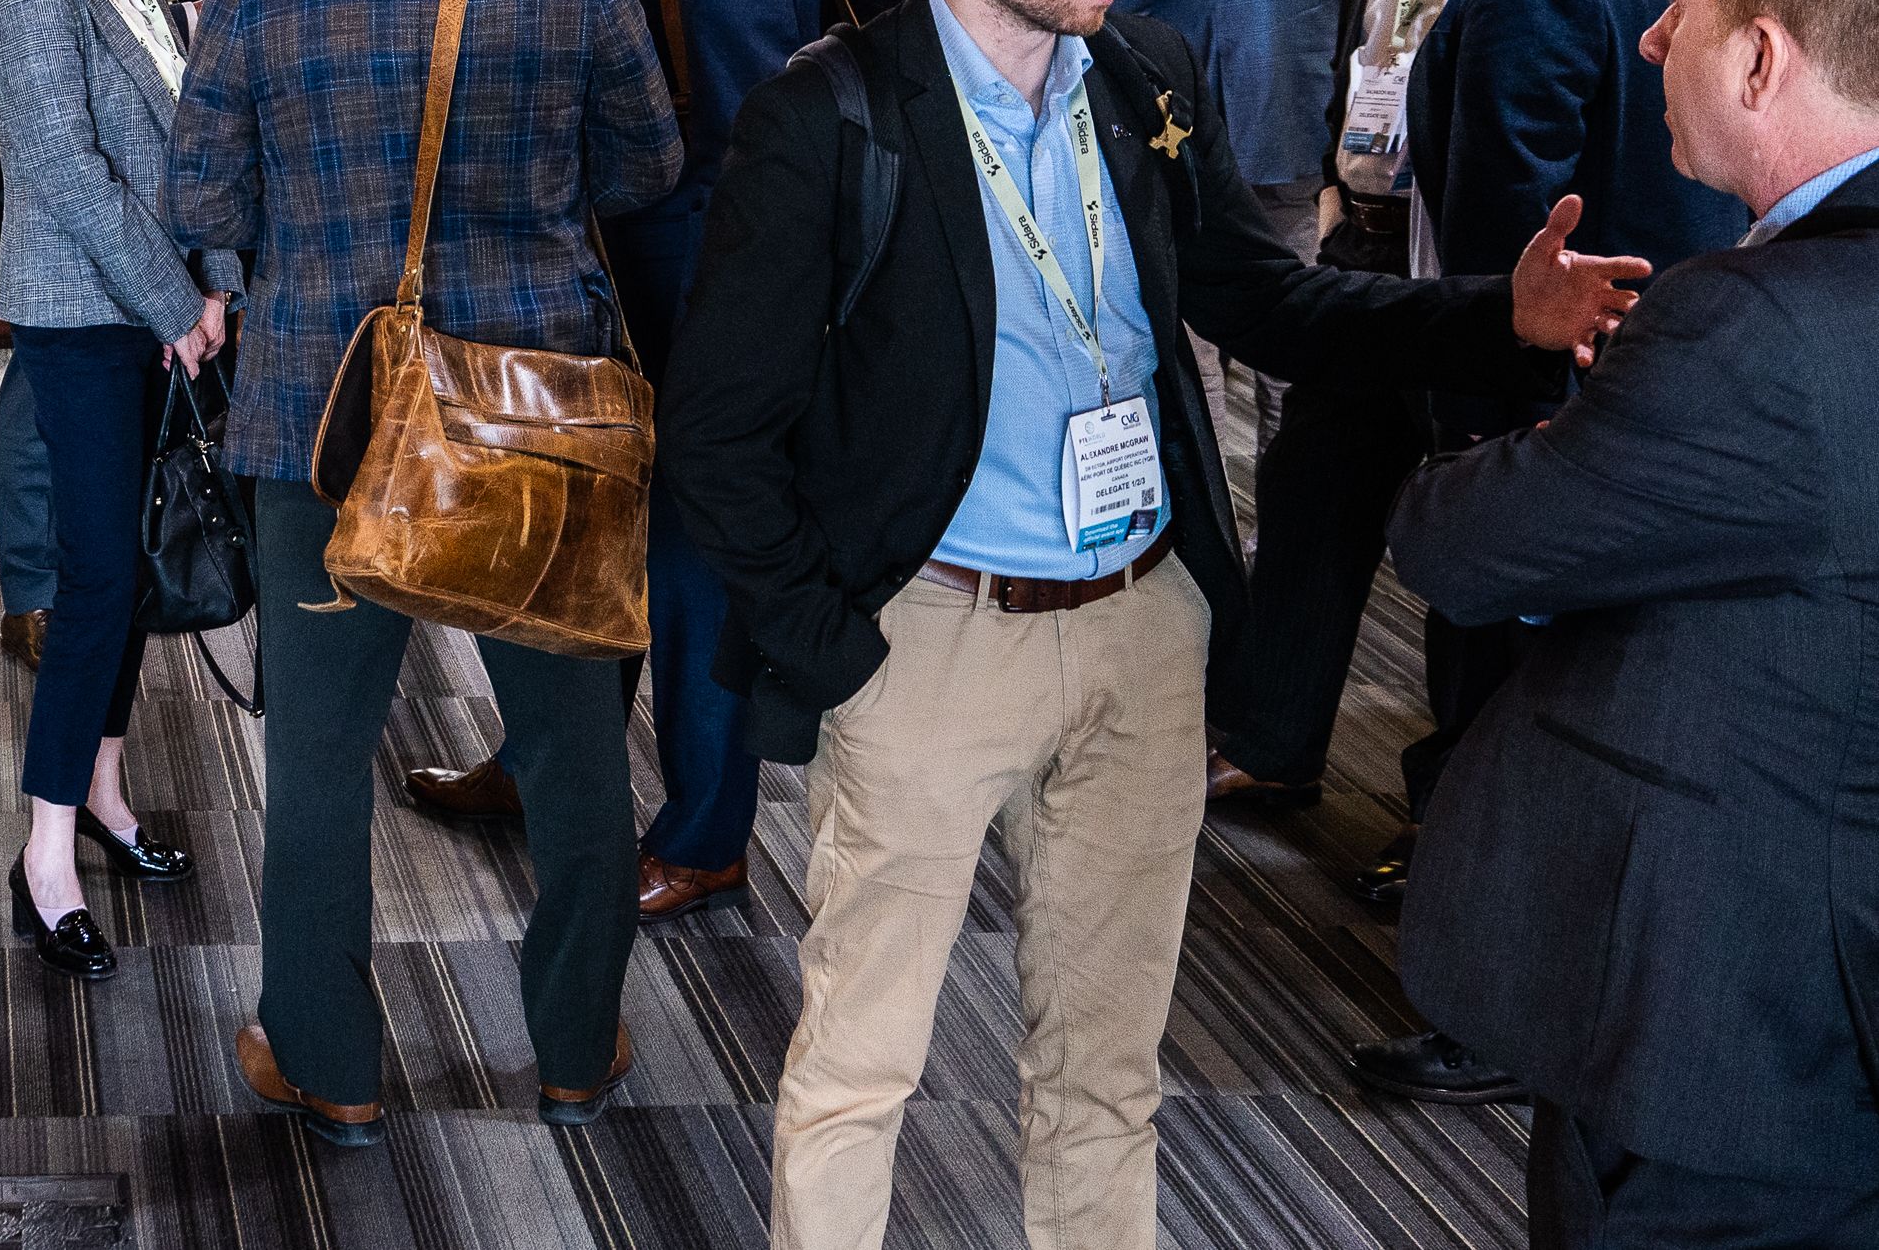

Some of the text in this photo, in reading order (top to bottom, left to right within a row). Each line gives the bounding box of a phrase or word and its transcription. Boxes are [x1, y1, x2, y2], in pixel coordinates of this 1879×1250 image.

[972, 131, 994, 165] Sidara
[1076, 119, 1089, 155] Sidara
[1018, 215, 1040, 249] Sidara
[1089, 213, 1099, 248] Sidara
[1066, 298, 1086, 330] Sidara
[1081, 435, 1149, 462] ALEXANDRE MCGRAW
[1107, 456, 1123, 466] AIRPORT
[1095, 477, 1146, 498] DELEGATE 1/2/3
[1111, 473, 1129, 482] CANADA
